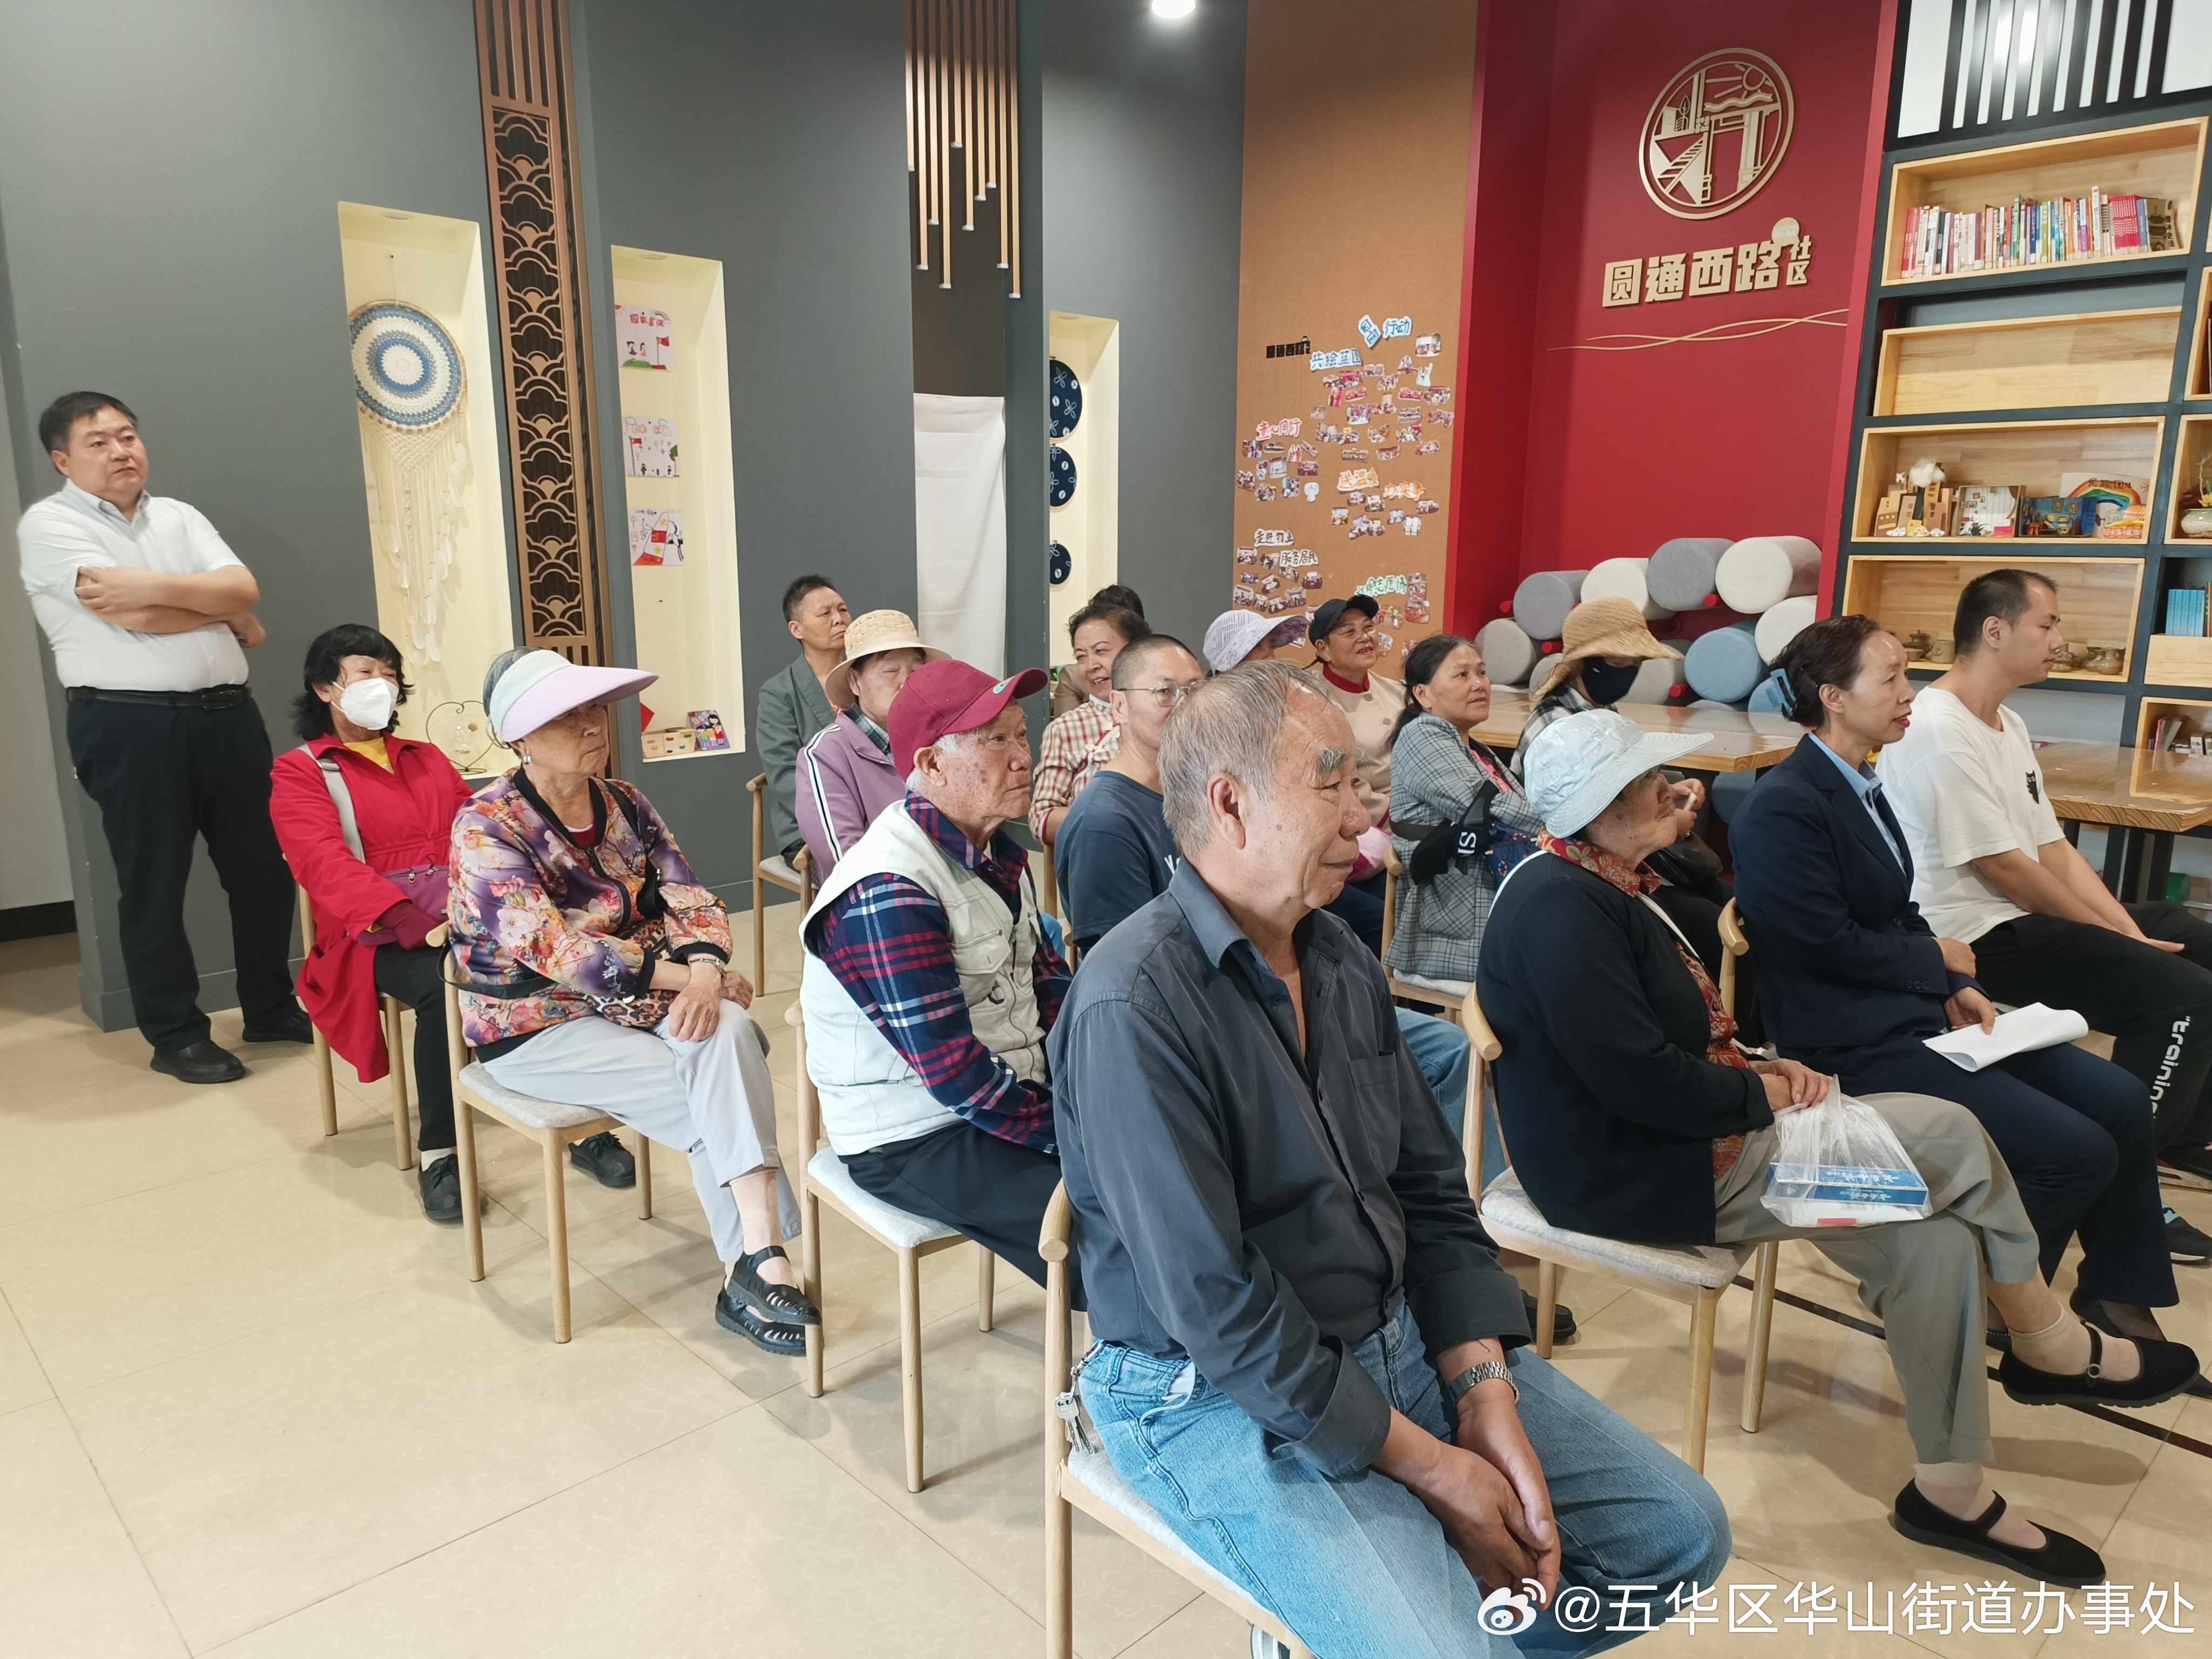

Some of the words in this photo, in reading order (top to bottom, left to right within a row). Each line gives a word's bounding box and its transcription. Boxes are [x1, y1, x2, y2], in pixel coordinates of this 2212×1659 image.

[1786, 235, 1811, 285] 社区
[1602, 241, 1781, 307] 圆通西路
[1385, 319, 1410, 335] 行动
[1311, 349, 1361, 368] 共绘蓝图
[1280, 551, 1317, 564] 服务居民
